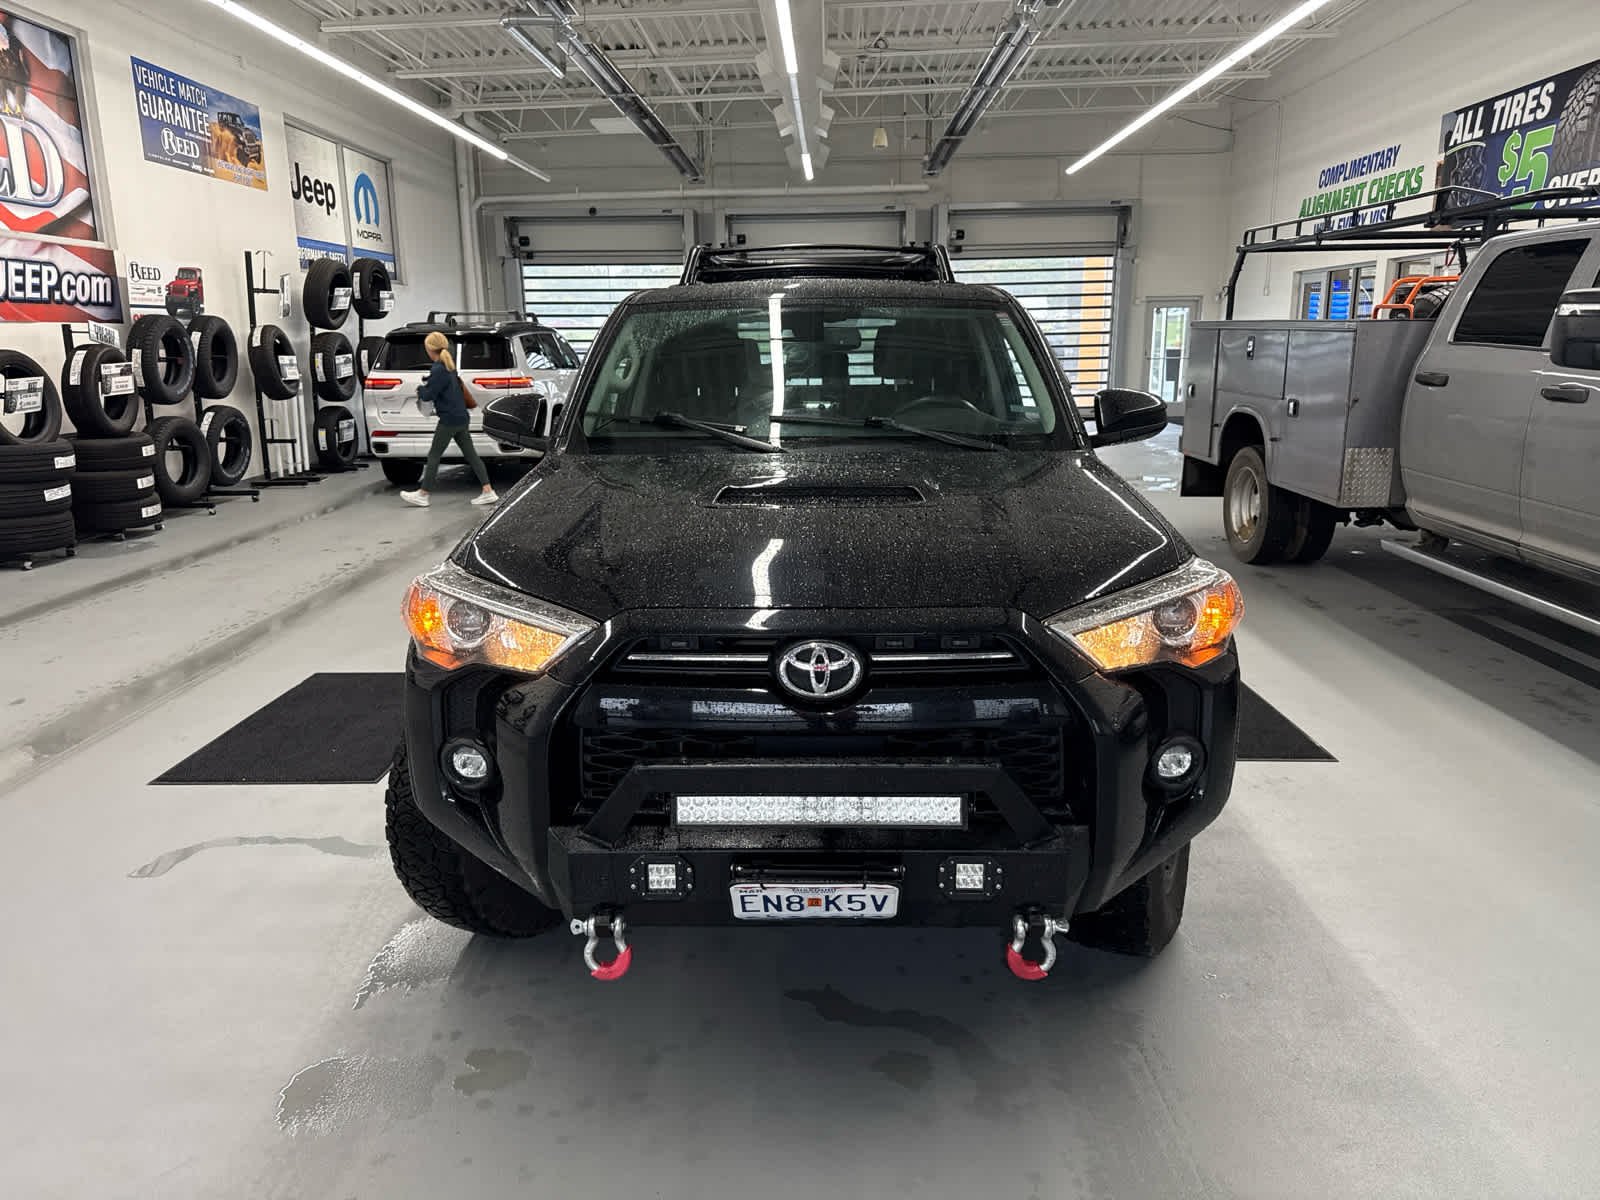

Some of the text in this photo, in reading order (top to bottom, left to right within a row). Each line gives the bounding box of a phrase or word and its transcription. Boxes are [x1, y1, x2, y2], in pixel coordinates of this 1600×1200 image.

[134, 64, 208, 108] VEHICLE MATCH
[139, 90, 212, 137] GUARANTEE
[1449, 82, 1556, 147] ALL TIRES
[162, 127, 200, 159] REED
[1318, 144, 1401, 188] COMPLIMENTARY
[1498, 124, 1557, 209] $5
[291, 162, 336, 216] Jeep
[1299, 165, 1424, 218] ALIGNMENT CHECKS
[129, 262, 161, 281] REED
[740, 894, 805, 913] EN8
[824, 894, 888, 913] K5V
